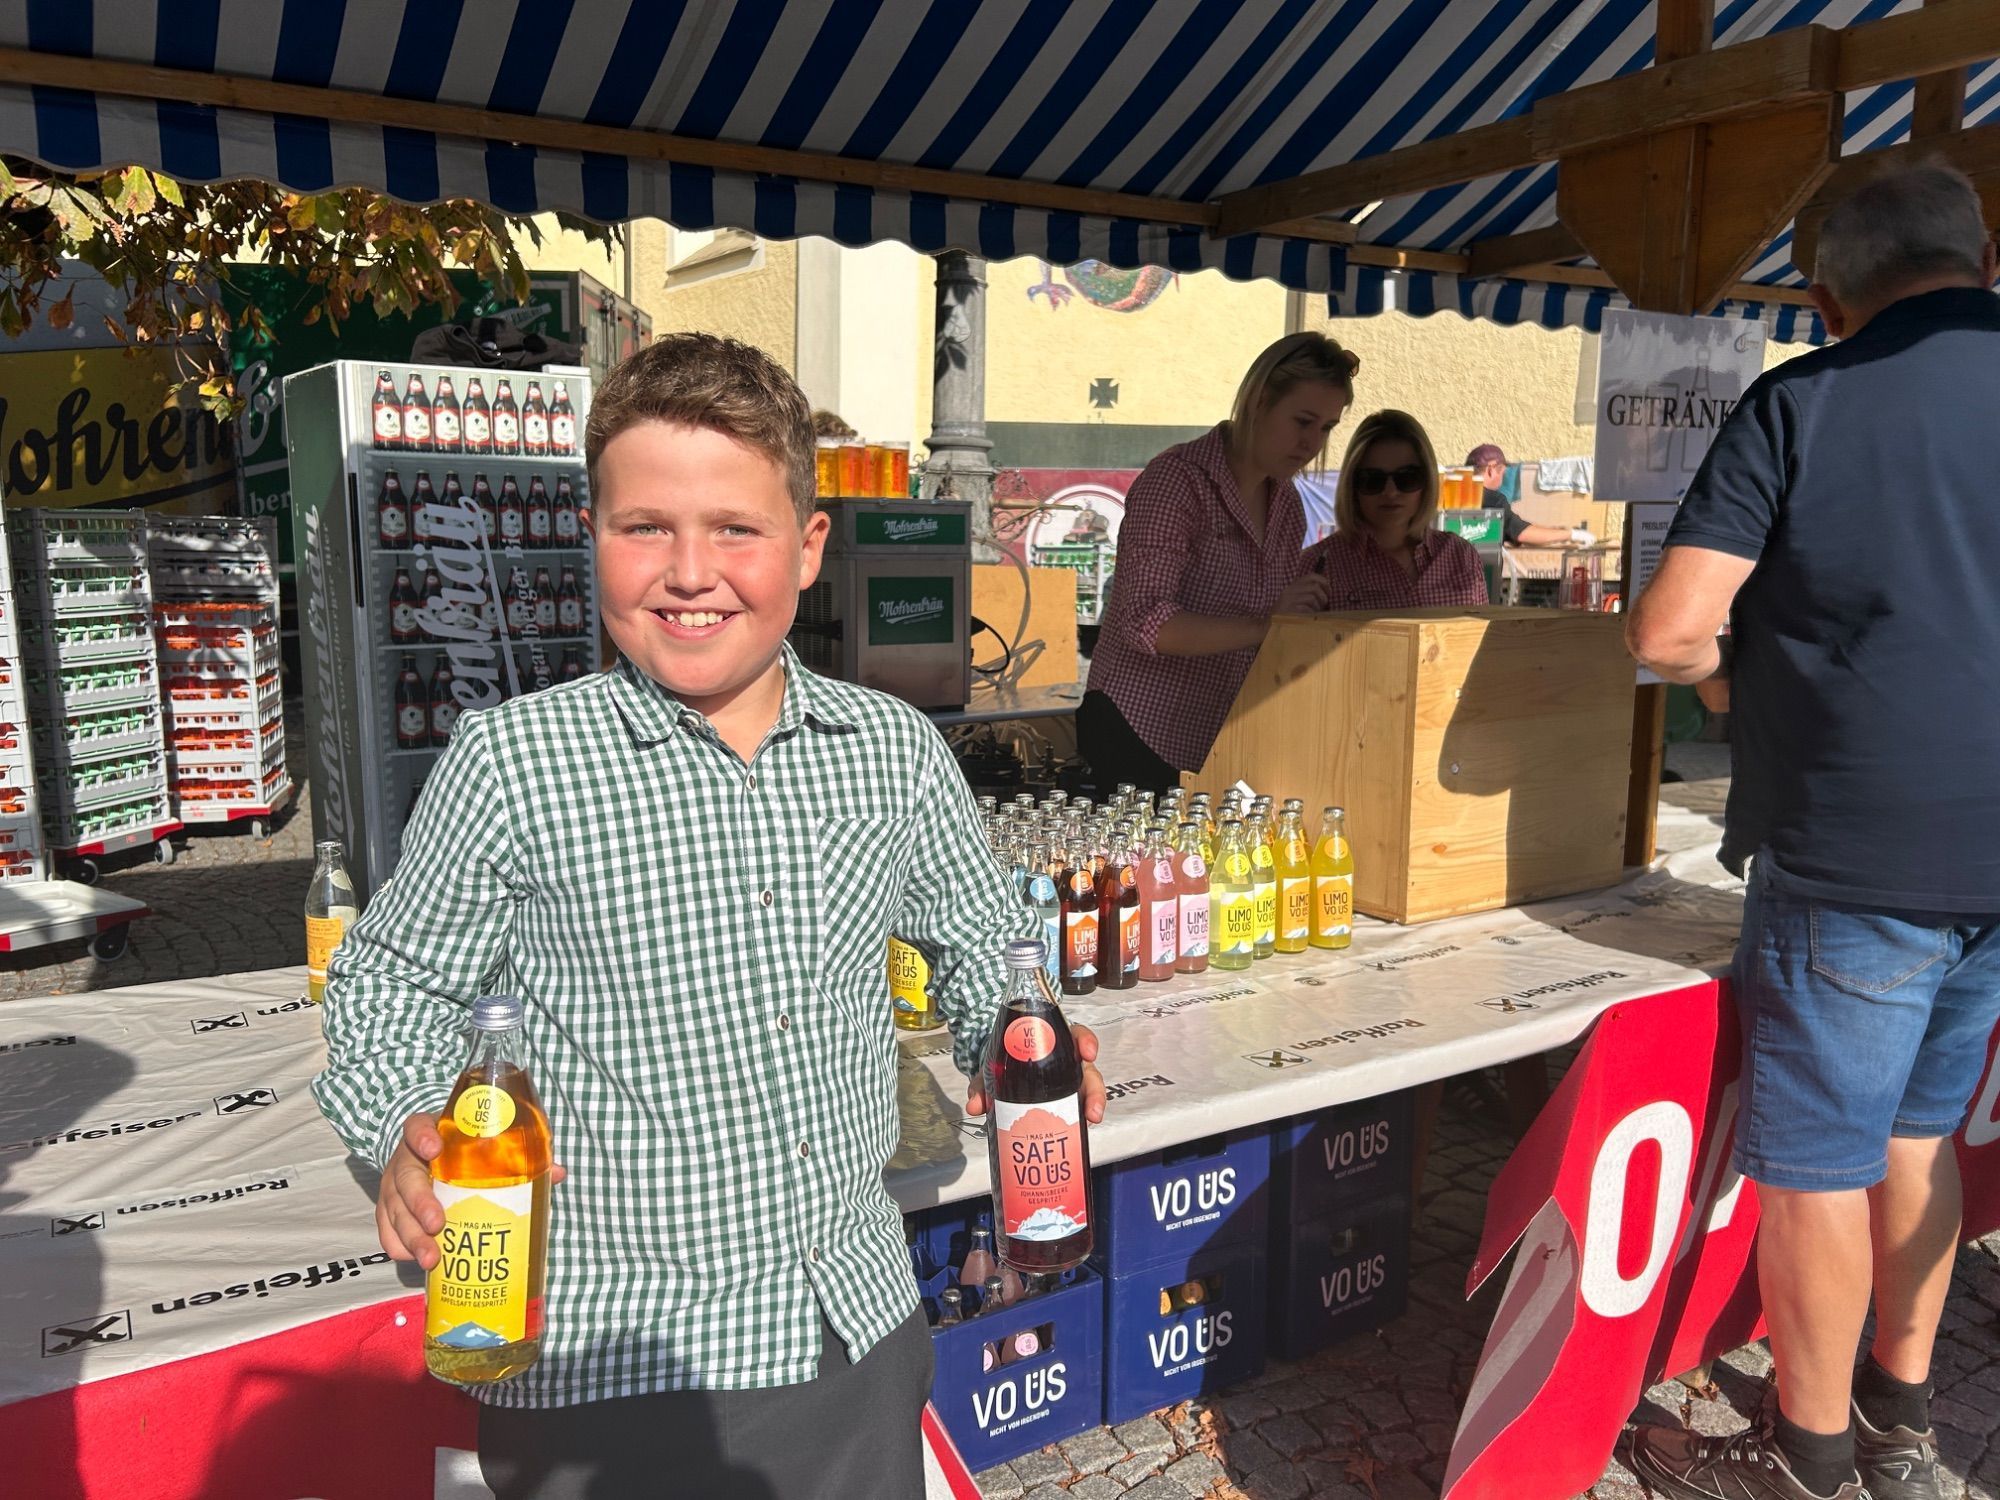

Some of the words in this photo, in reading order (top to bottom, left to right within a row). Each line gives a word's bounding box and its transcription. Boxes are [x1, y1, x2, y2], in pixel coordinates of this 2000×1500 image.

[1323, 892, 1348, 906] LIMO
[1324, 905, 1336, 915] VO
[1228, 908, 1251, 922] LIMO
[1228, 922, 1241, 932] VO
[891, 948, 917, 965] SAFT
[1511, 969, 1630, 1000] Raiffeisen
[1288, 1018, 1427, 1051] Raiffeisen
[477, 1098, 491, 1110] VO
[1012, 1136, 1068, 1164] SAFT
[1323, 1131, 1354, 1170] VO
[1360, 1120, 1389, 1159] ÜS
[1013, 1164, 1041, 1186] VO
[1046, 1160, 1071, 1184] ÜS
[117, 1178, 290, 1216] Raiffeisen
[1150, 1178, 1191, 1222] VO
[1198, 1167, 1236, 1210] ÜS
[443, 1227, 511, 1256] SAFT
[442, 1254, 470, 1281] VO
[477, 1257, 510, 1282] ÜS
[1320, 1267, 1351, 1308] VO
[1356, 1254, 1385, 1294] ÜS
[441, 1284, 508, 1300] BODENSEE
[473, 1299, 507, 1308] GESPRITZT
[1148, 1324, 1189, 1369] VO
[1195, 1310, 1233, 1353] ÜS
[972, 1381, 1017, 1429] VO
[1025, 1362, 1067, 1410] ÜS
[989, 1424, 1007, 1438] NICHT
[1008, 1419, 1020, 1431] VON
[1020, 1408, 1050, 1426] IRGENDWO
